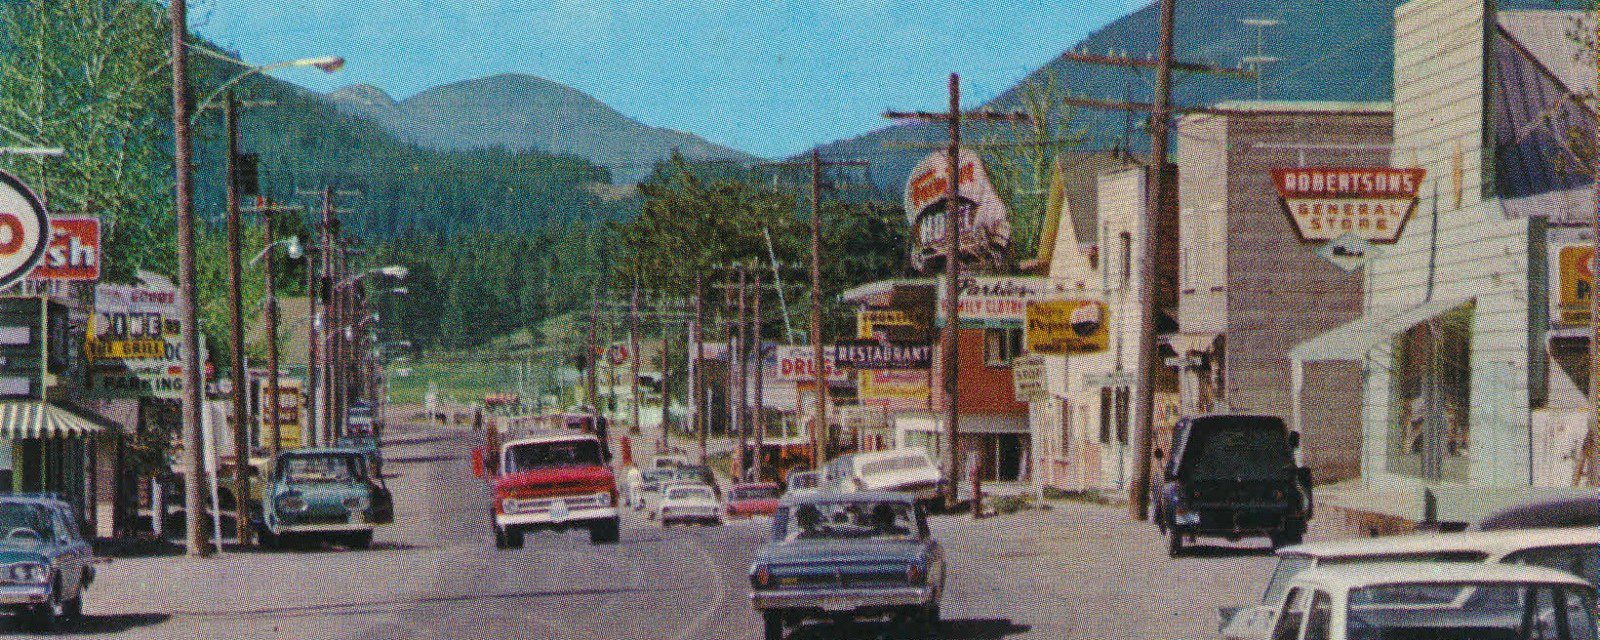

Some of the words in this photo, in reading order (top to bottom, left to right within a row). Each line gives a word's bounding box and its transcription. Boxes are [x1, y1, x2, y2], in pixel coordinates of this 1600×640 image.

[1284, 172, 1413, 192] ROBERTSONS
[1298, 203, 1399, 217] GENERAL
[1310, 218, 1388, 232] STORE
[47, 236, 95, 267] sh
[839, 346, 930, 361] RESTAURANT
[104, 376, 183, 391] PARKING
